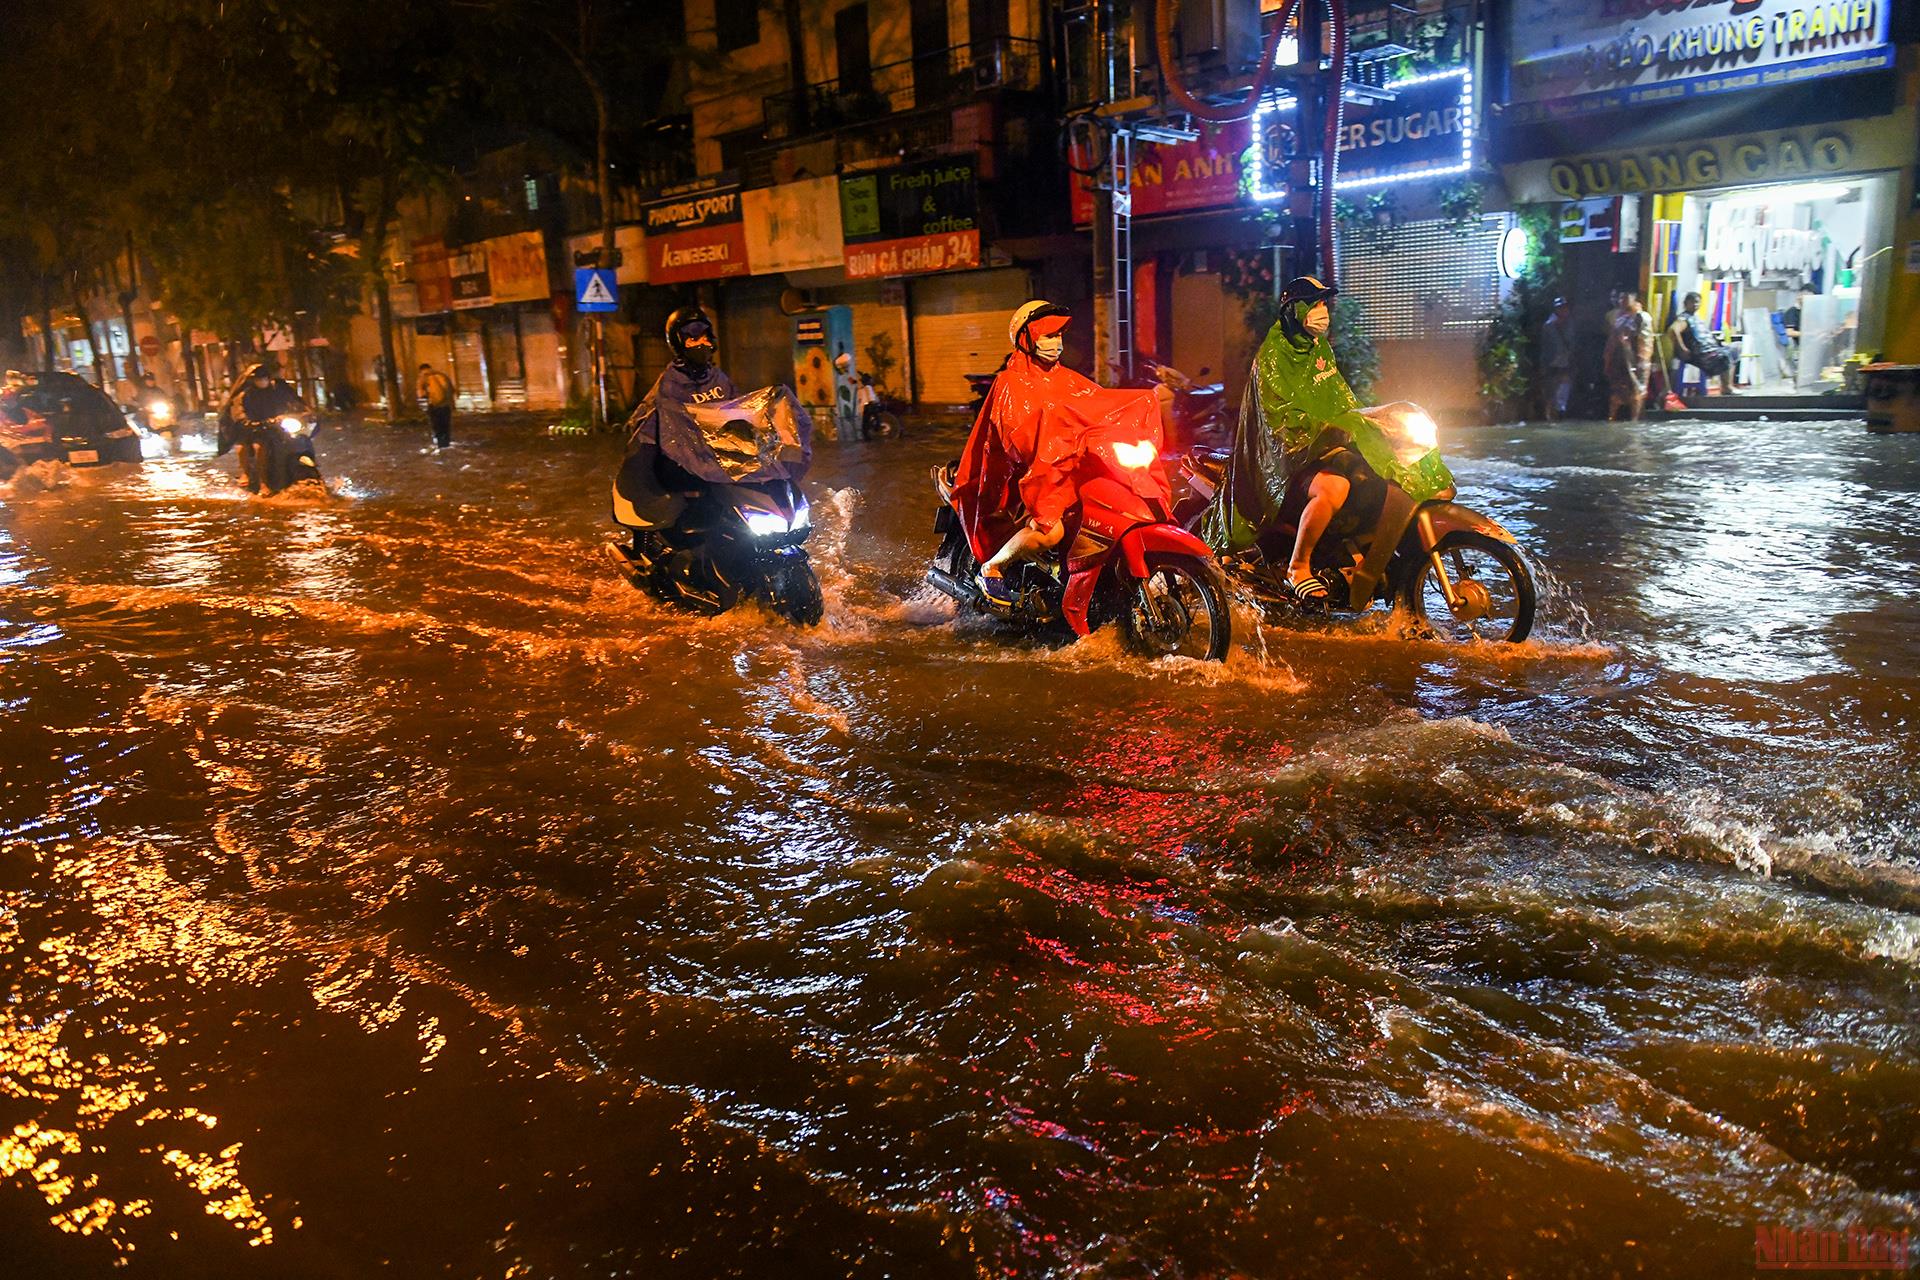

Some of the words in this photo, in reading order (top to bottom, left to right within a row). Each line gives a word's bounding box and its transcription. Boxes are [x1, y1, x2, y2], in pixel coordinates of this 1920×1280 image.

[1774, 0, 1873, 44] TRANH
[1370, 108, 1464, 148] SUGAR
[890, 173, 931, 190] Fresh
[934, 167, 970, 187] juice
[1174, 153, 1233, 181] ANH
[695, 194, 735, 222] SPORT
[922, 195, 936, 213] &
[922, 216, 973, 234] coffee
[947, 235, 974, 267] 34
[691, 386, 725, 404] DHC
